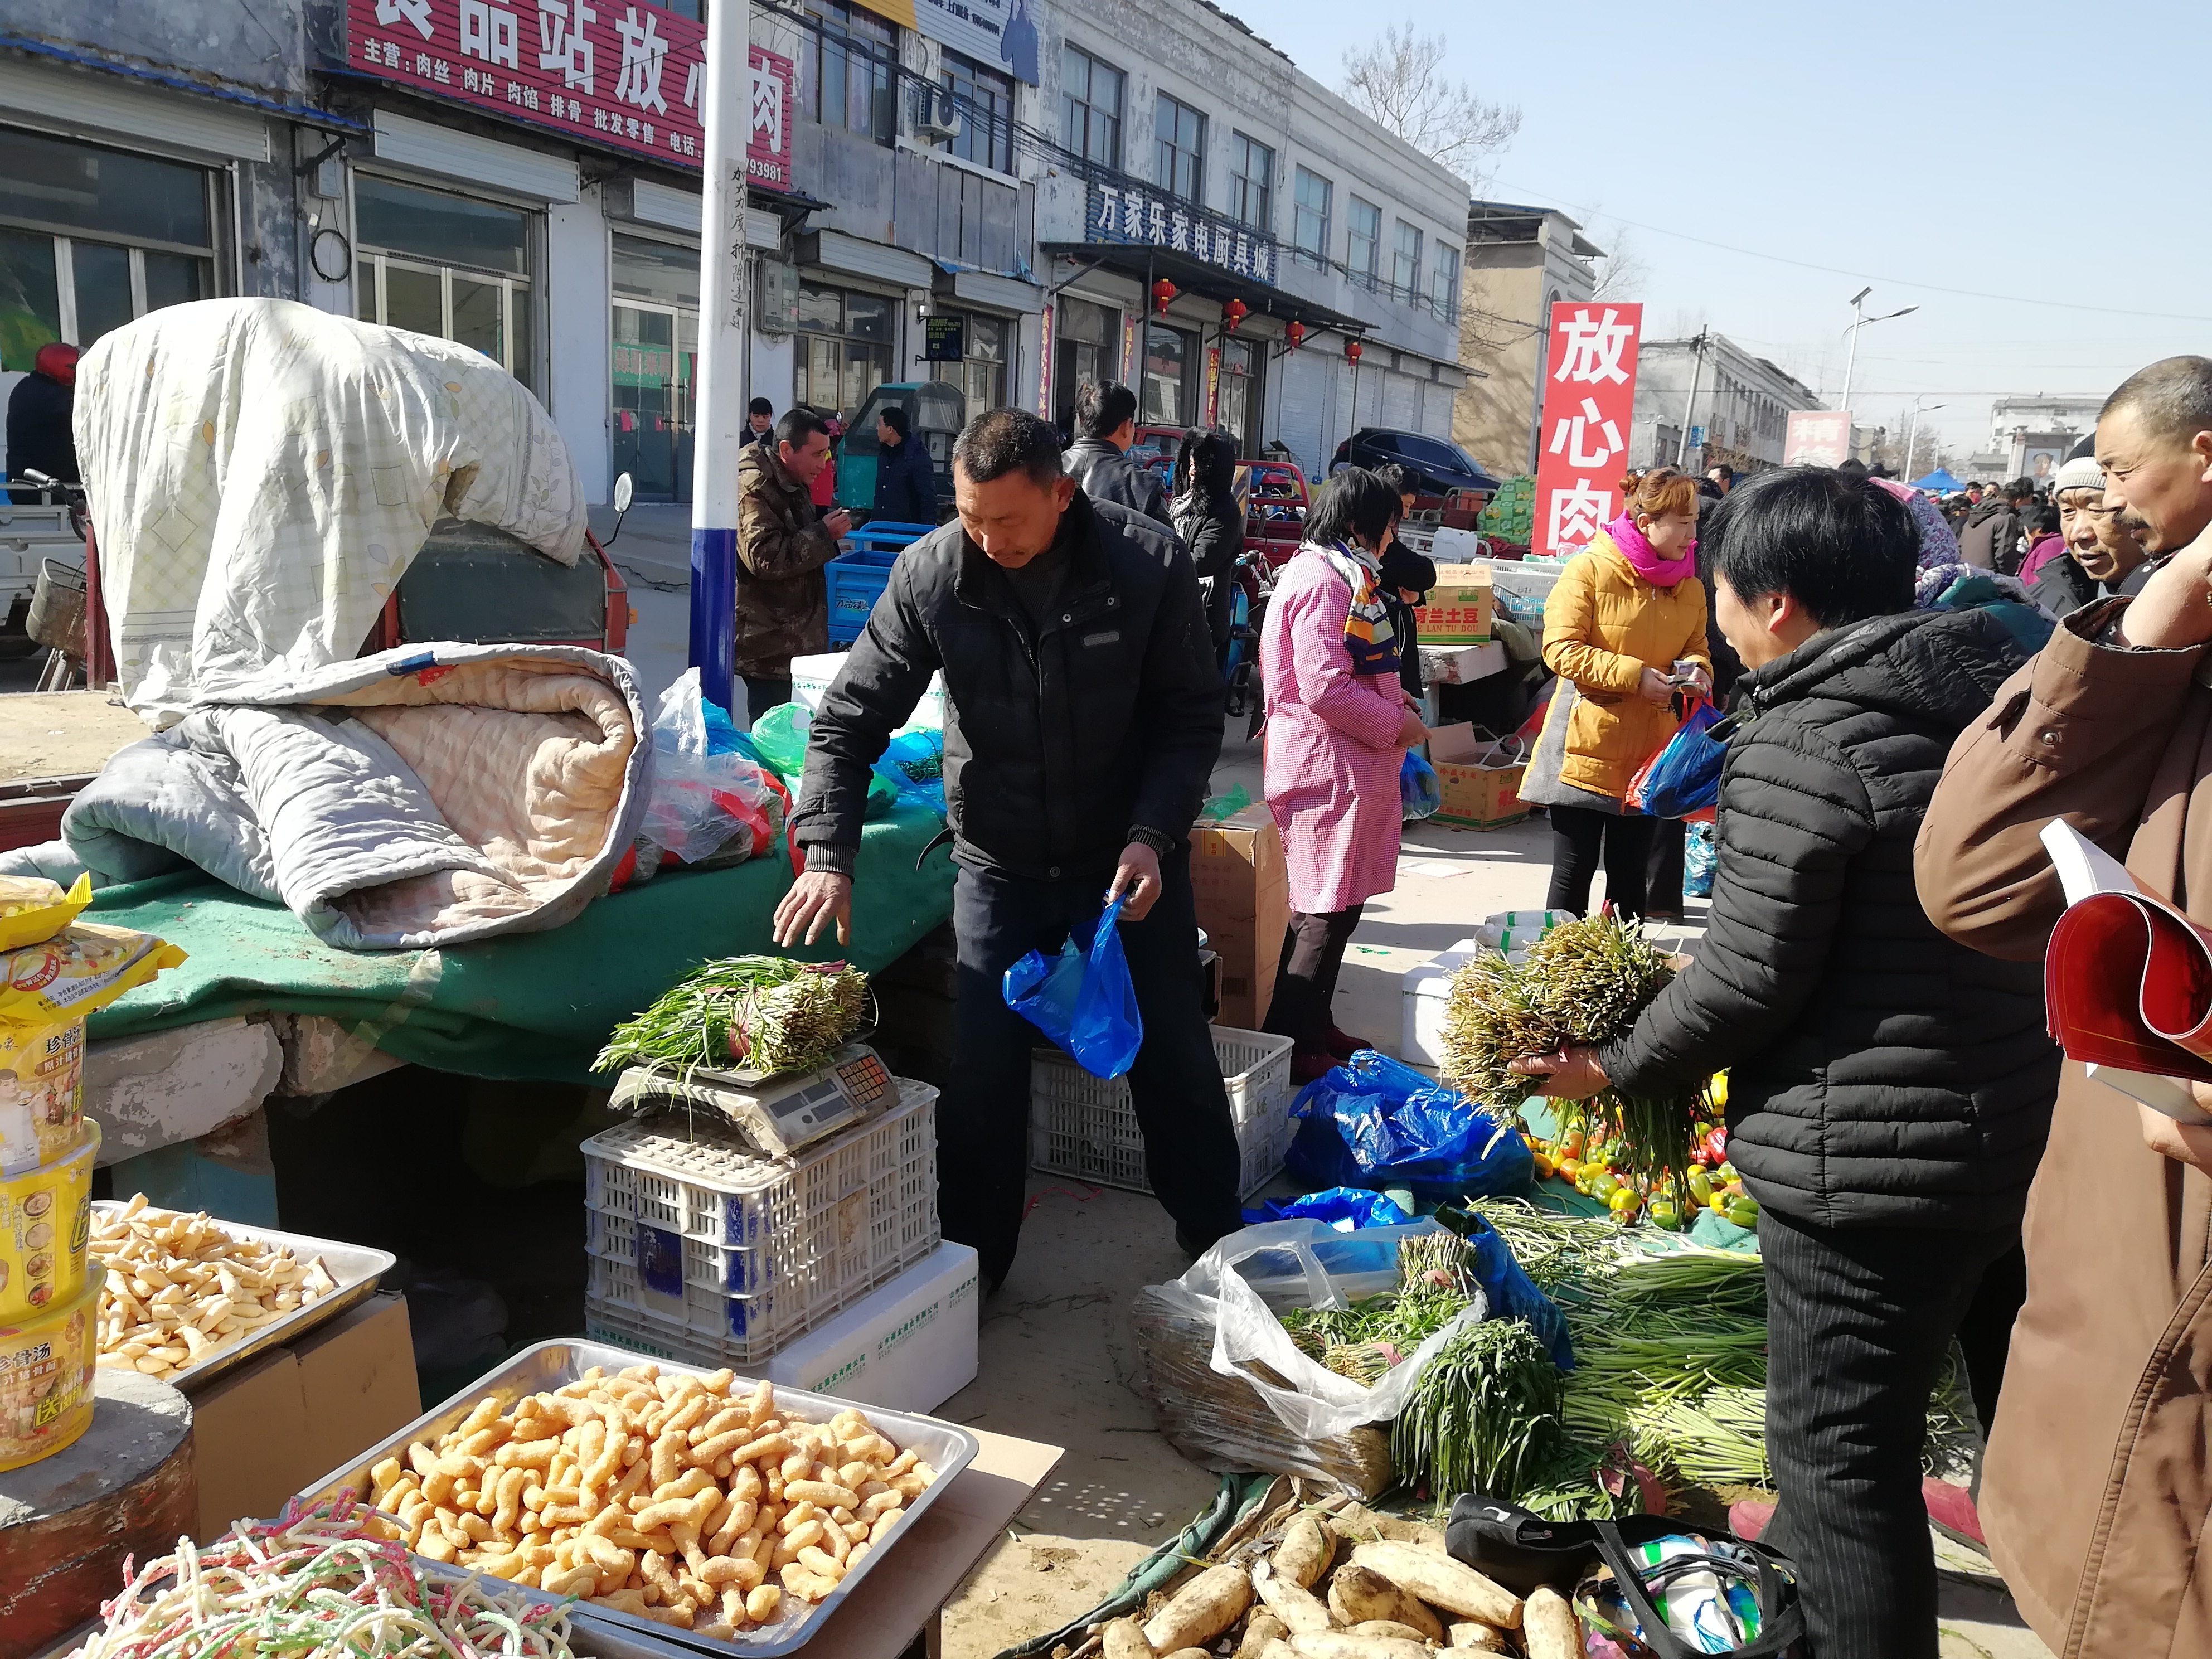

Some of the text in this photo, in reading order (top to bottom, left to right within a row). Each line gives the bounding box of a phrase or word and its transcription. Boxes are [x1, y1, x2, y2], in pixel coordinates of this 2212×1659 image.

[464, 67, 494, 96] 肉片
[508, 81, 539, 111] 肉馅
[550, 94, 581, 123] 排骨
[594, 108, 654, 145] 批发零售
[1098, 184, 1269, 280] 万家乐家电厨具城
[1547, 308, 1634, 551] 放心肉
[1413, 607, 1479, 624] 荷兰土豆
[0, 1361, 56, 1387] 汁猪骨面
